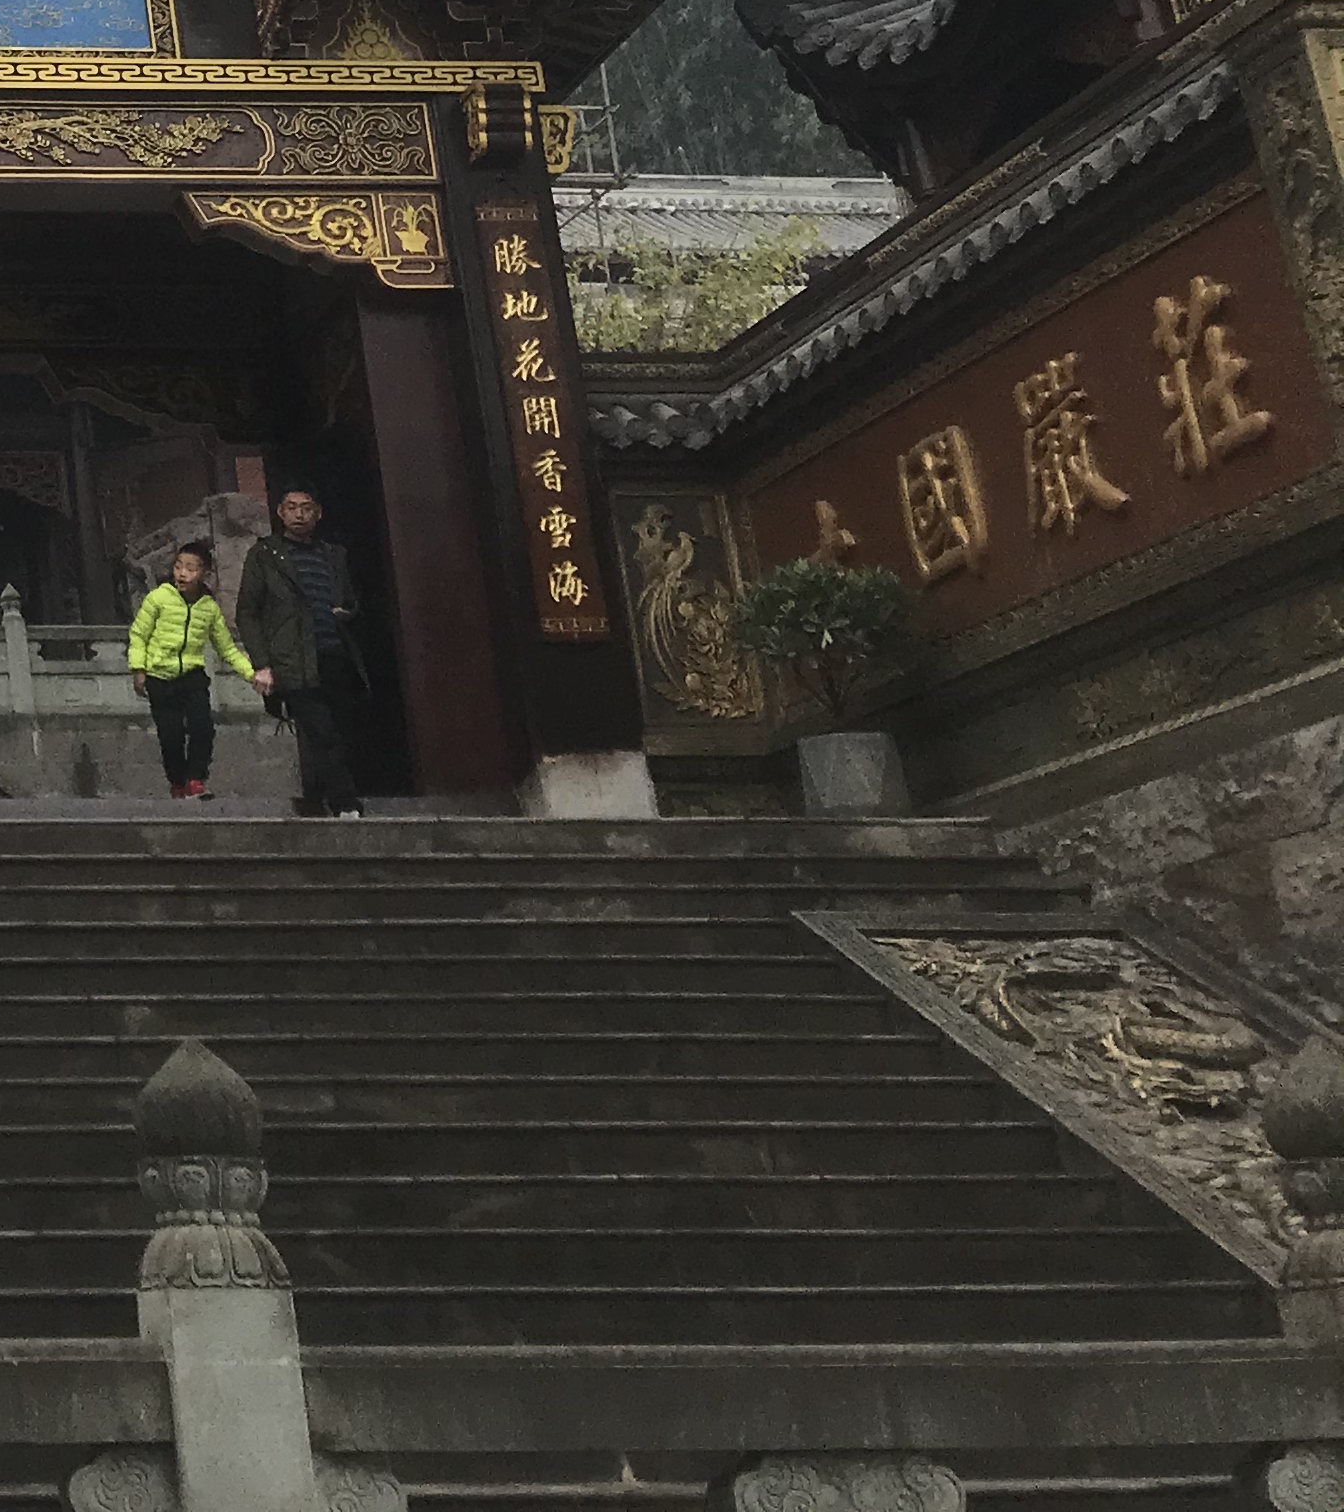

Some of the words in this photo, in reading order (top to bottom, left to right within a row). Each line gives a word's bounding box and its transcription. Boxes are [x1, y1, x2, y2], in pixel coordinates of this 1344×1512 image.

[492, 234, 592, 606] 勝地花開香雪海
